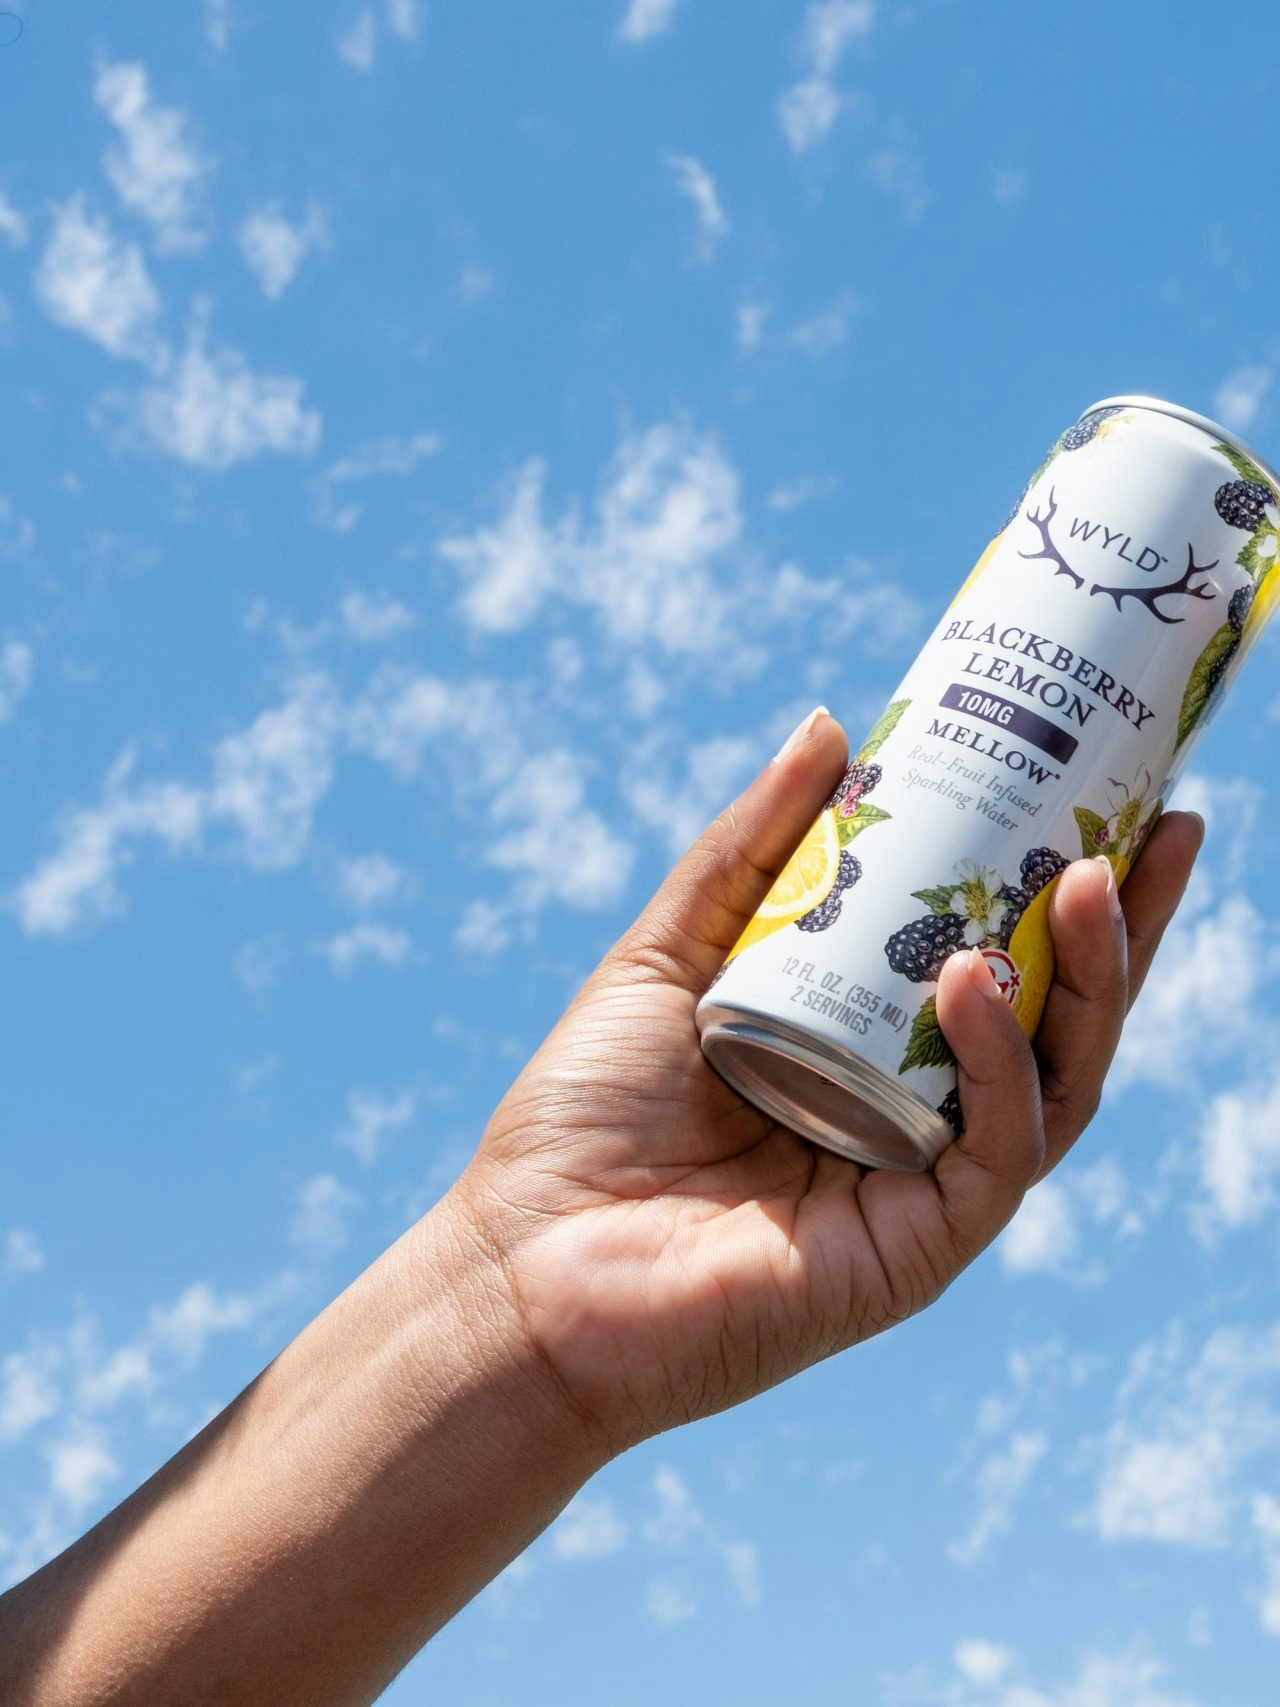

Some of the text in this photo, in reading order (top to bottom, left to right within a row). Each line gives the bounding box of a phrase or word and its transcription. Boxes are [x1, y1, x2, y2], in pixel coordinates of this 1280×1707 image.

[941, 619, 1156, 731] BLACKBERRY
[958, 690, 1015, 725] 10MG
[961, 651, 1098, 728] LEMON
[902, 767, 1019, 831] Sparkling Water
[908, 744, 1043, 817] Real-Fruit Infused
[782, 957, 908, 1033] 12 FL. OZ. (355 ML)
[790, 985, 873, 1035] 2 SERVINGS
